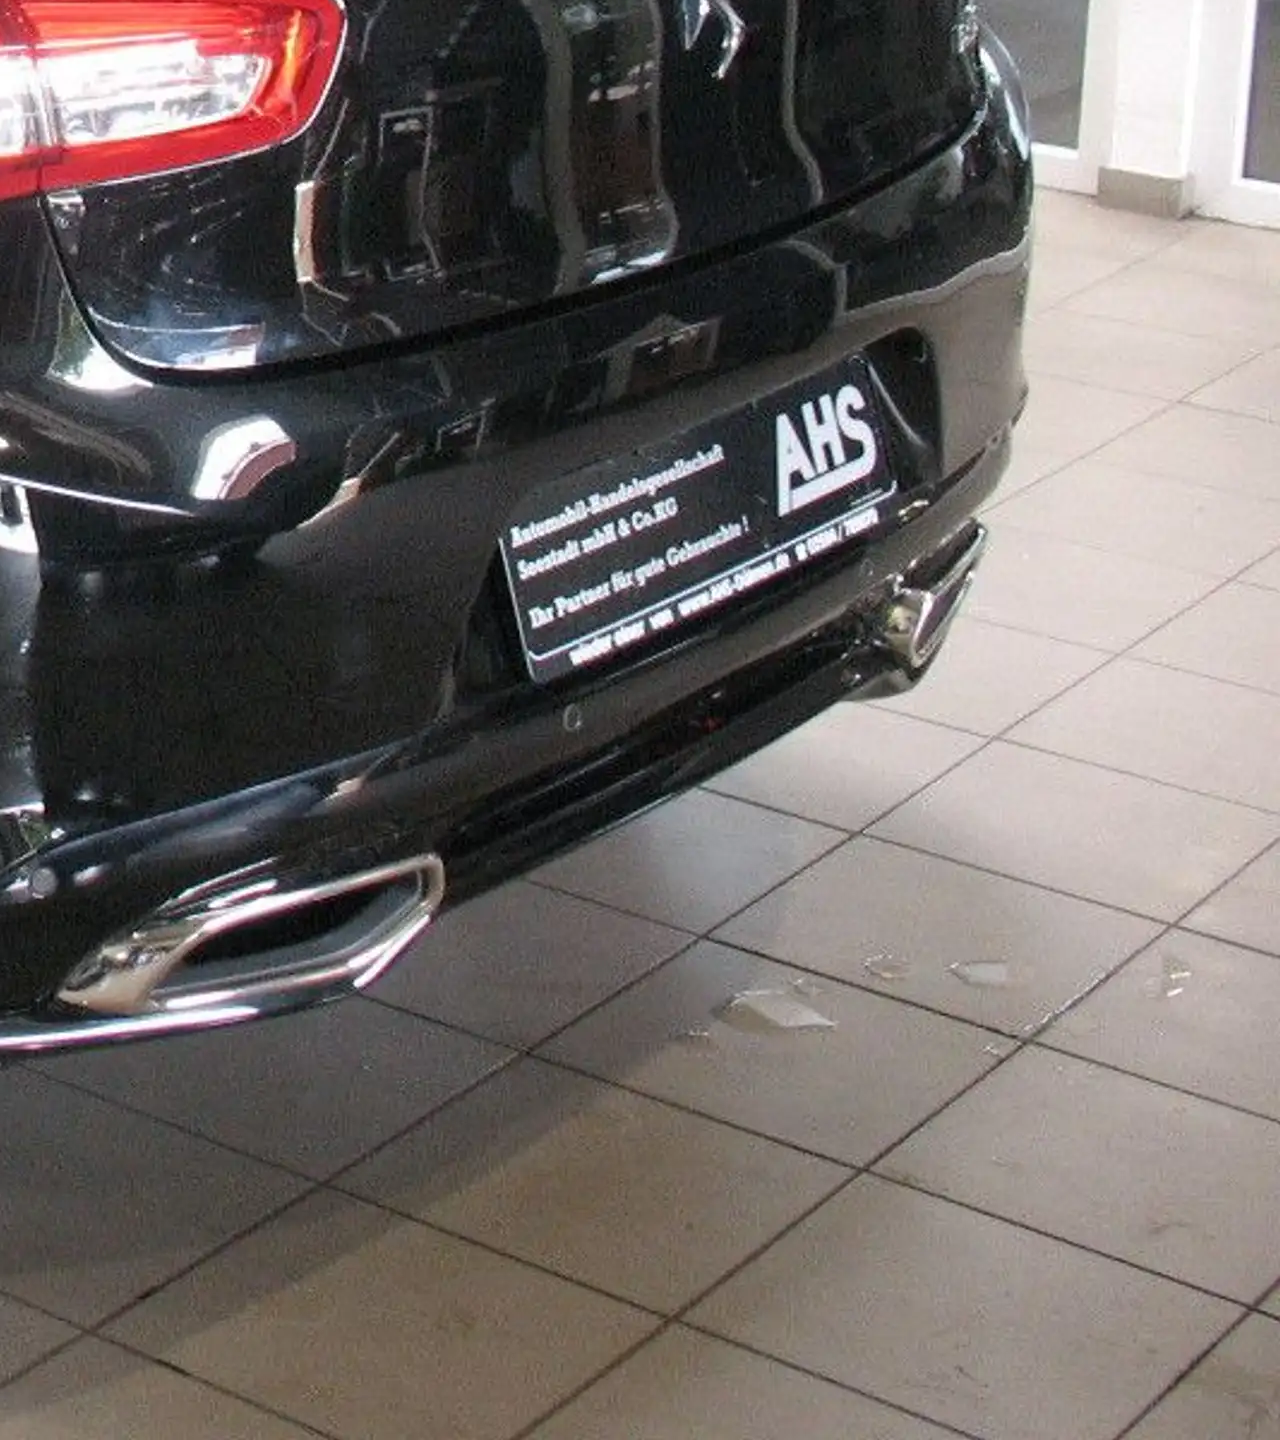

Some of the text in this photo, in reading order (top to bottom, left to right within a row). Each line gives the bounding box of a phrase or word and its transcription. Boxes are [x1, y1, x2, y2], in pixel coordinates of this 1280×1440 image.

[776, 385, 876, 517] AHS
[581, 522, 617, 554] mbH
[618, 518, 631, 537] &
[631, 496, 679, 531] Co.KG
[529, 606, 555, 629] Ihr
[554, 583, 611, 617] Partner
